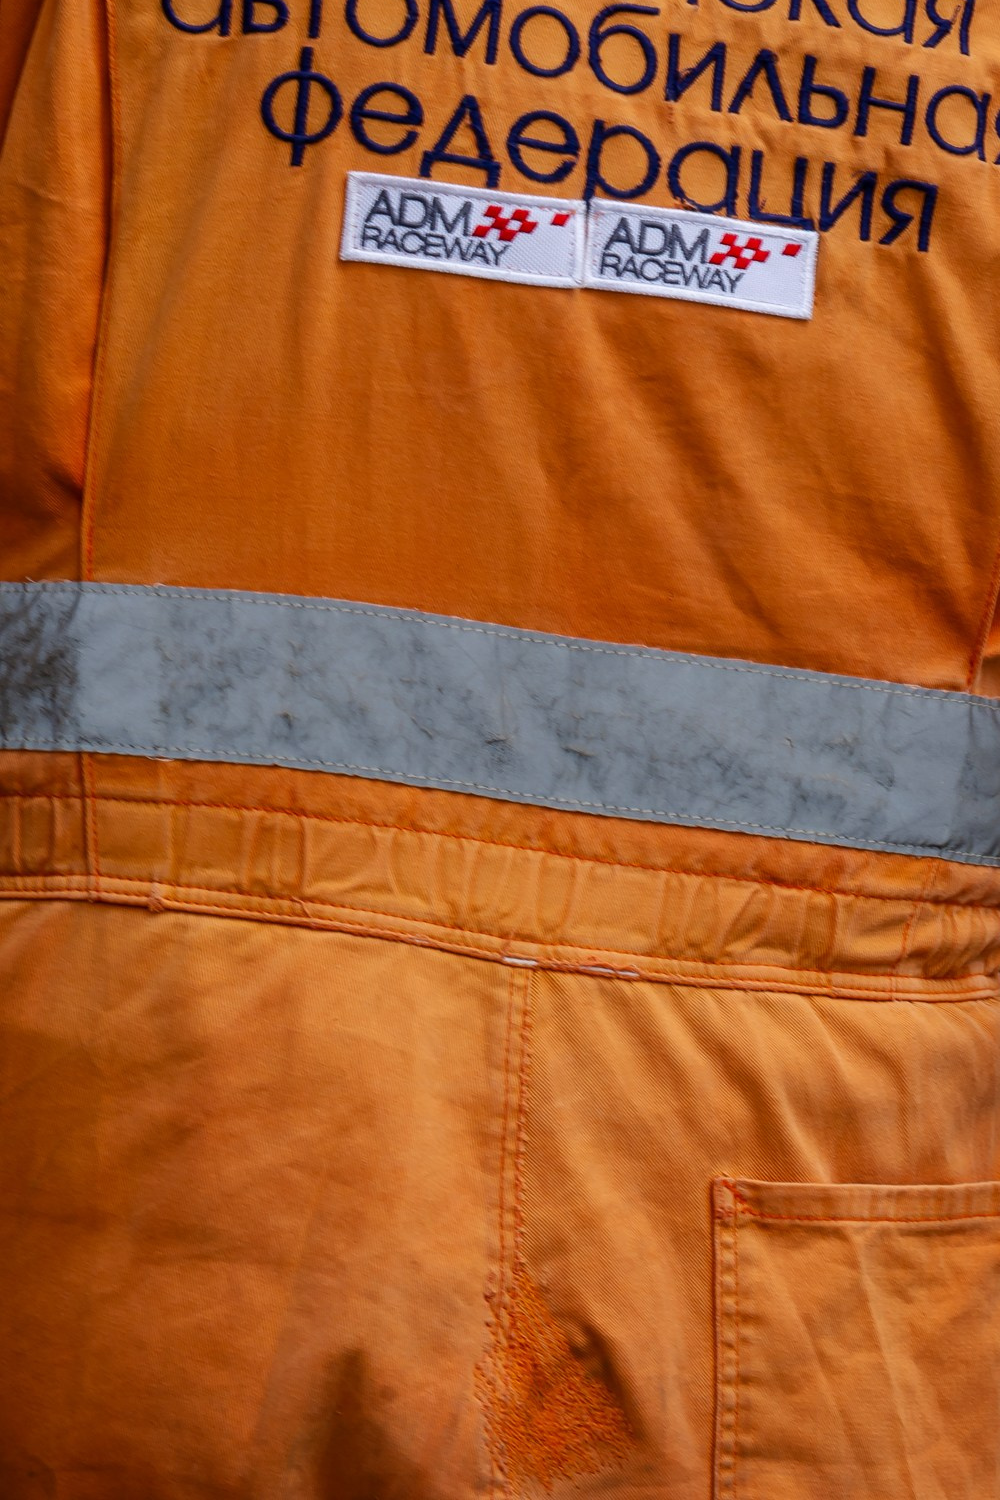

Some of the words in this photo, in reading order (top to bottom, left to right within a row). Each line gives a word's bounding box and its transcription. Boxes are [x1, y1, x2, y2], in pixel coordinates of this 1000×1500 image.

[260, 46, 939, 253] федерация
[364, 188, 473, 237] ADM
[361, 223, 512, 266] RACEWAY
[603, 216, 710, 264] ADM
[600, 251, 746, 294] RACEWAY
